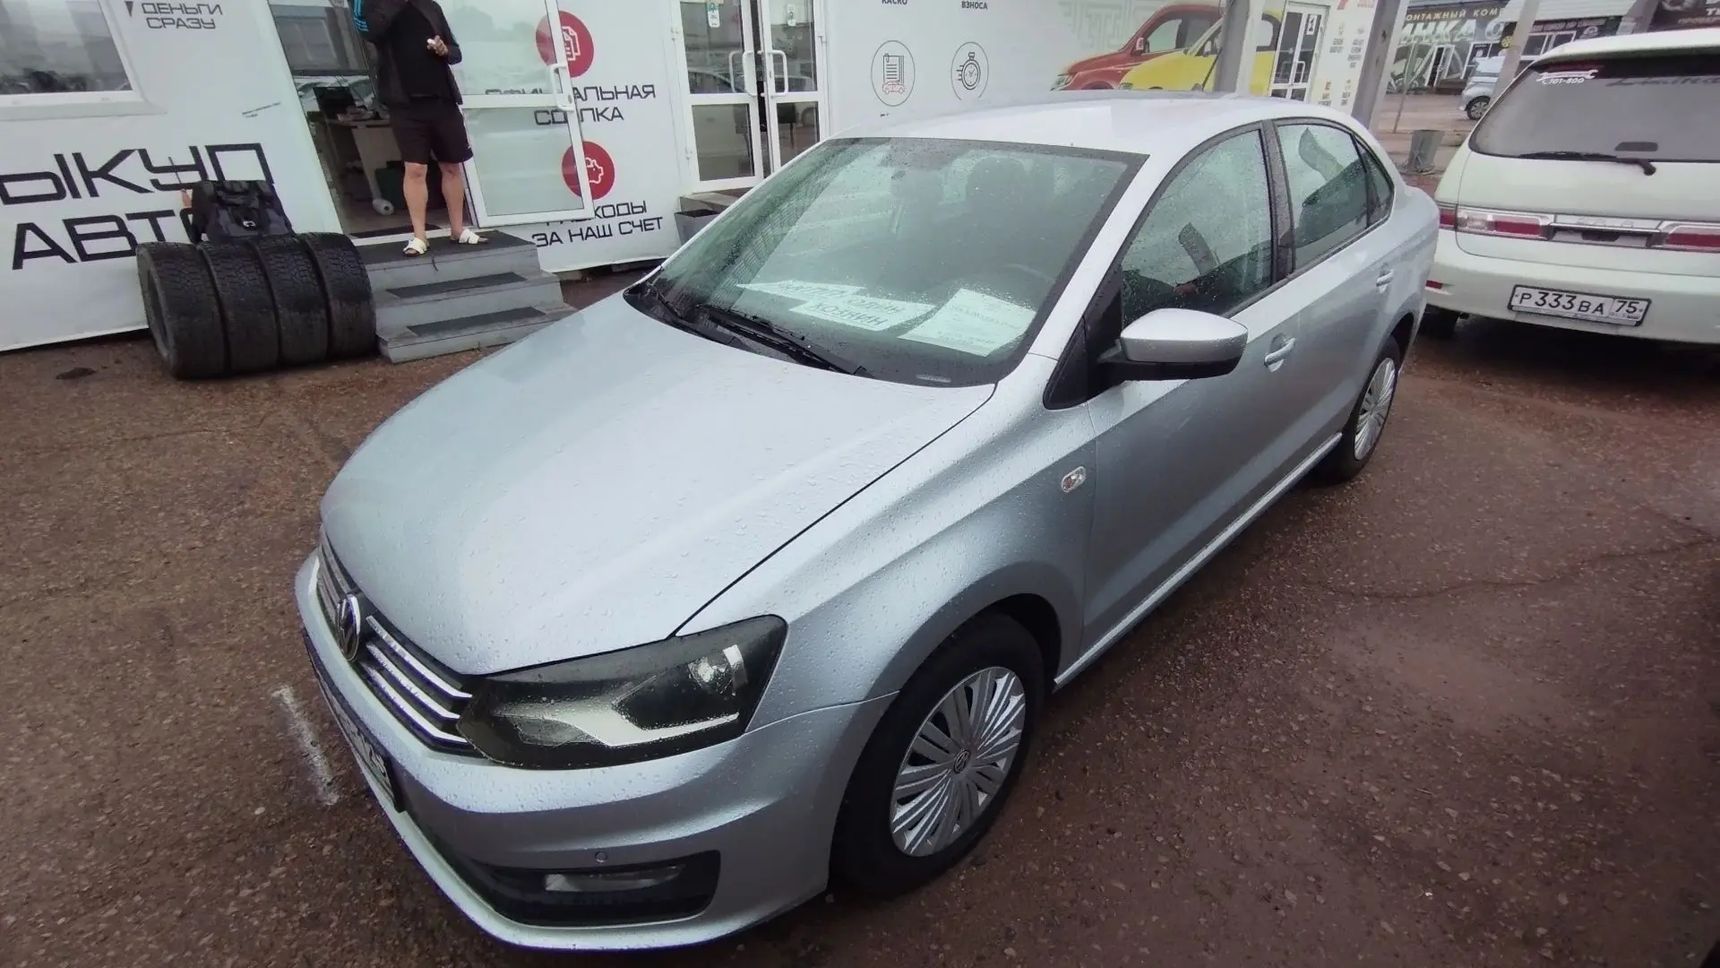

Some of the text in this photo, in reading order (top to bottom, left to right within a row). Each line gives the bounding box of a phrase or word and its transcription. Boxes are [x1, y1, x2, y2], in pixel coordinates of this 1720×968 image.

[141, 3, 223, 15] ДЕНЬГИ
[146, 17, 216, 29] СРАЗУ
[534, 106, 624, 126] СДЛКА
[531, 216, 663, 248] ЗА НАШ СЧЕТ
[1615, 300, 1640, 314] 75
